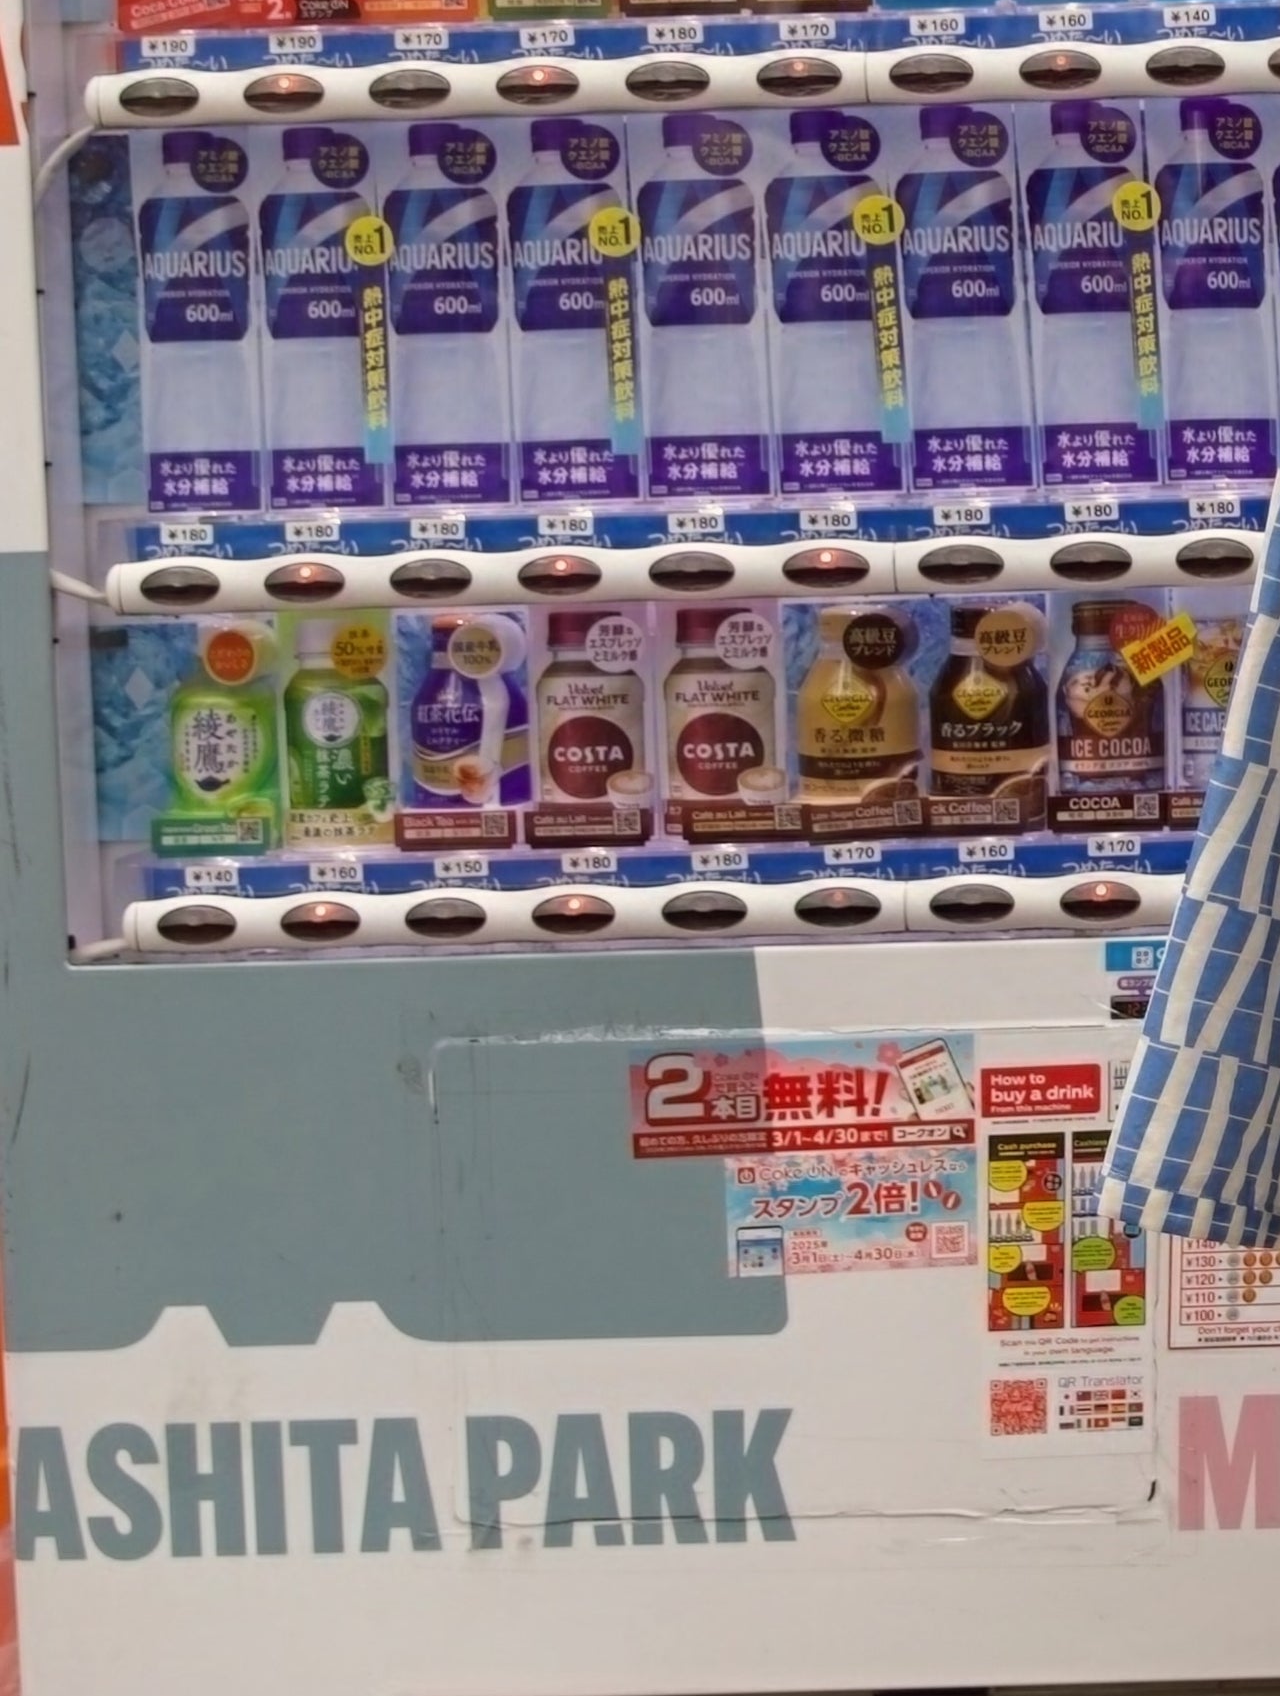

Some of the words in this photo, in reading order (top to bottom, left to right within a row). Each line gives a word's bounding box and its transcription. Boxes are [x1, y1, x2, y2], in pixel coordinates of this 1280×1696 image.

[1171, 9, 1210, 24] ¥140
[653, 26, 698, 41] ¥180
[643, 233, 752, 263] AQUARIUS
[144, 248, 246, 280] AQUARIUS
[389, 241, 495, 275] AQUARIUS
[849, 628, 897, 645] 高級豆
[850, 644, 896, 657] ブレンド
[1130, 621, 1195, 675] 新製品
[416, 703, 481, 724] 紅茶花伝
[554, 744, 625, 763] COSTA
[683, 741, 756, 761] COSTA
[1070, 738, 1094, 759] ICE
[1098, 737, 1152, 758] COCOA
[1069, 796, 1121, 811] COCOA
[442, 860, 483, 875] ¥150
[990, 1074, 1027, 1086] How
[1029, 1073, 1046, 1085] to
[763, 1068, 889, 1121] 無料!
[991, 1089, 1026, 1105] buy
[1029, 1089, 1043, 1101] a
[1046, 1084, 1095, 1100] drink
[711, 1096, 759, 1120] 本目
[896, 1126, 948, 1141] コークオン
[790, 1239, 829, 1251] 2025年
[1057, 1375, 1077, 1388] QR
[1081, 1373, 1144, 1387] Translator
[14, 1416, 443, 1563] ASHITA
[465, 1407, 797, 1551] PARK
